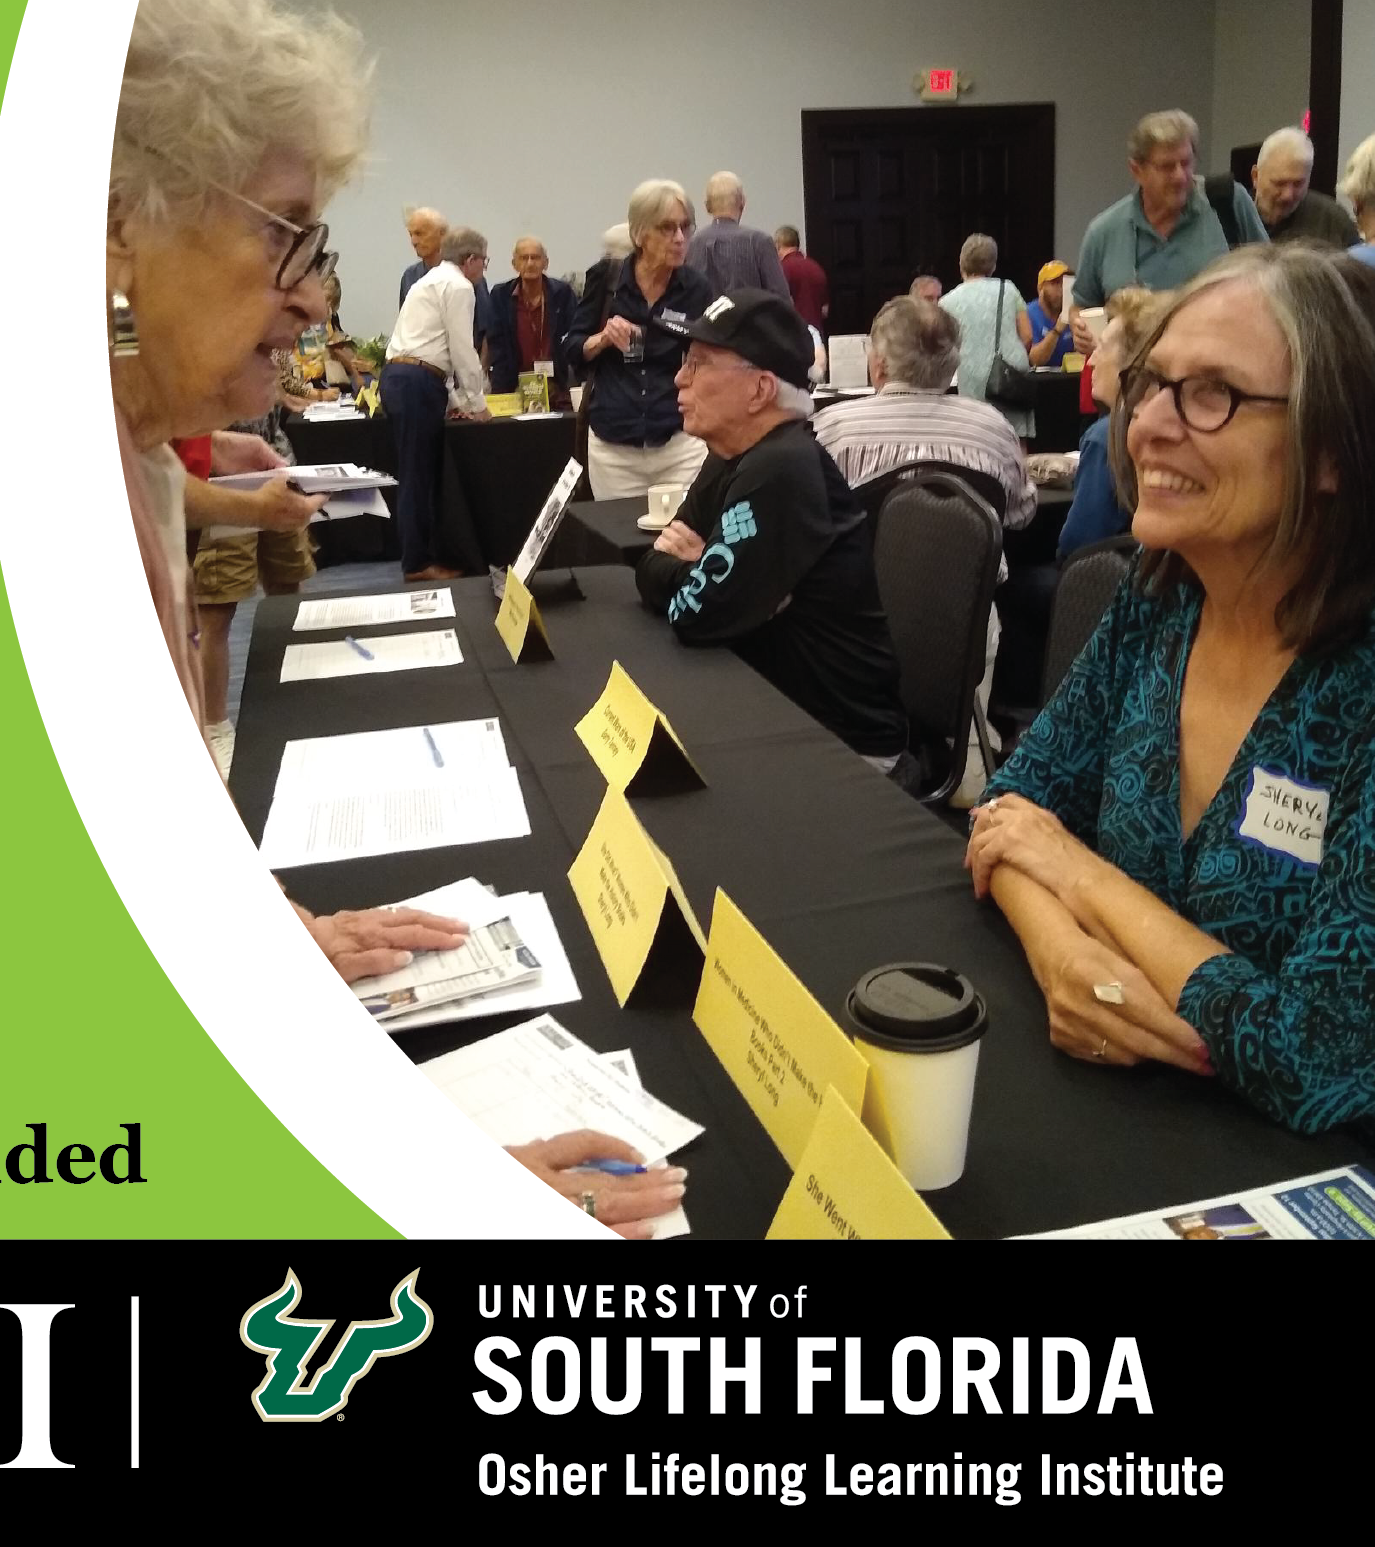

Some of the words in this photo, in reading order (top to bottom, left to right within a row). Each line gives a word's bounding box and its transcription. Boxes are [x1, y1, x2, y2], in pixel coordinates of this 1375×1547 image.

[1263, 811, 1321, 840] LONG
[747, 1050, 766, 1082] Sheryl
[764, 1077, 779, 1108] Long
[749, 1028, 767, 1061] Books
[767, 1053, 781, 1077] Part
[760, 1016, 773, 1043] Who
[790, 1057, 807, 1089] Make
[807, 1081, 819, 1104] the
[806, 1174, 823, 1205] She
[823, 1194, 848, 1237] Went
